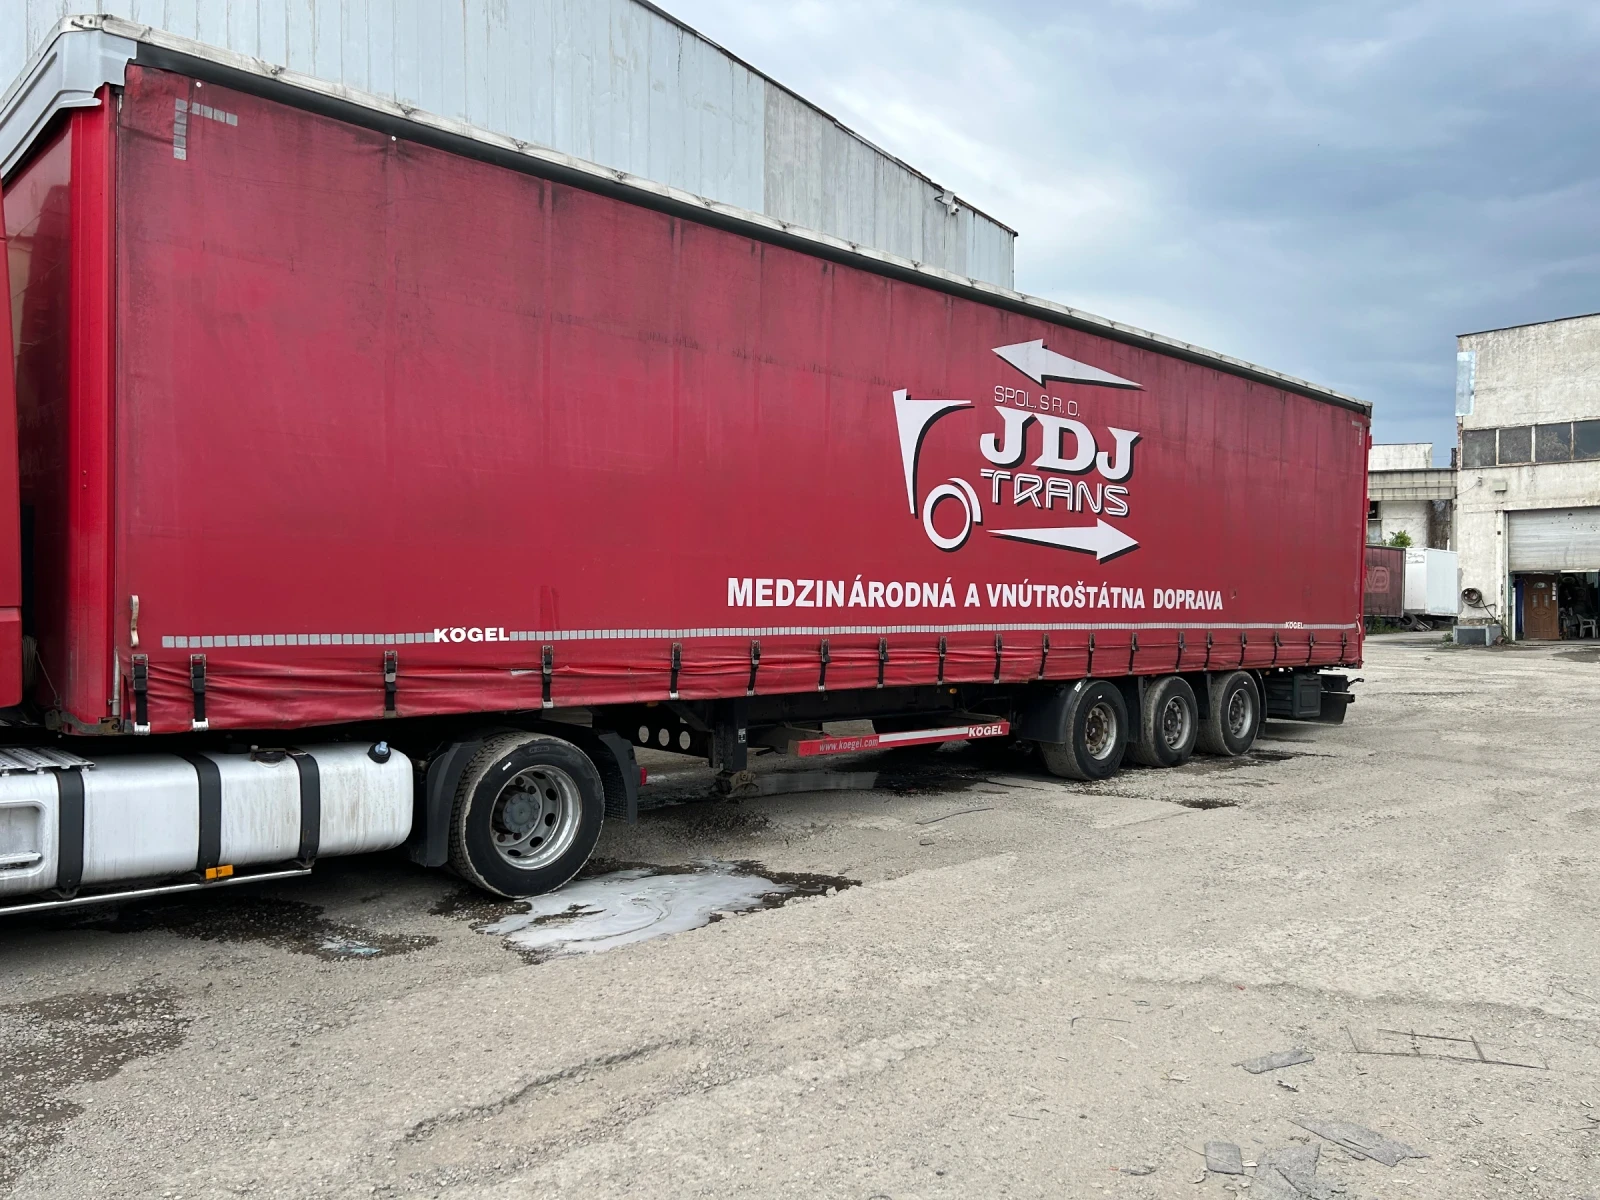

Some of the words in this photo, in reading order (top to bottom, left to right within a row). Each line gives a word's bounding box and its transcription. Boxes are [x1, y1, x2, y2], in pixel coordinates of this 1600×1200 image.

[994, 385, 1037, 409] SPOL.
[979, 405, 1141, 480] JDJ
[980, 468, 1130, 516] TRANS
[727, 574, 956, 608] MEDZINÁRODNÁ
[964, 583, 981, 608] A
[986, 579, 1146, 609] VNÚTROŠTÁTNA
[1153, 588, 1223, 610] DOPRAVA
[433, 626, 510, 643] KÖGEL
[819, 737, 879, 752] www.koegel.com
